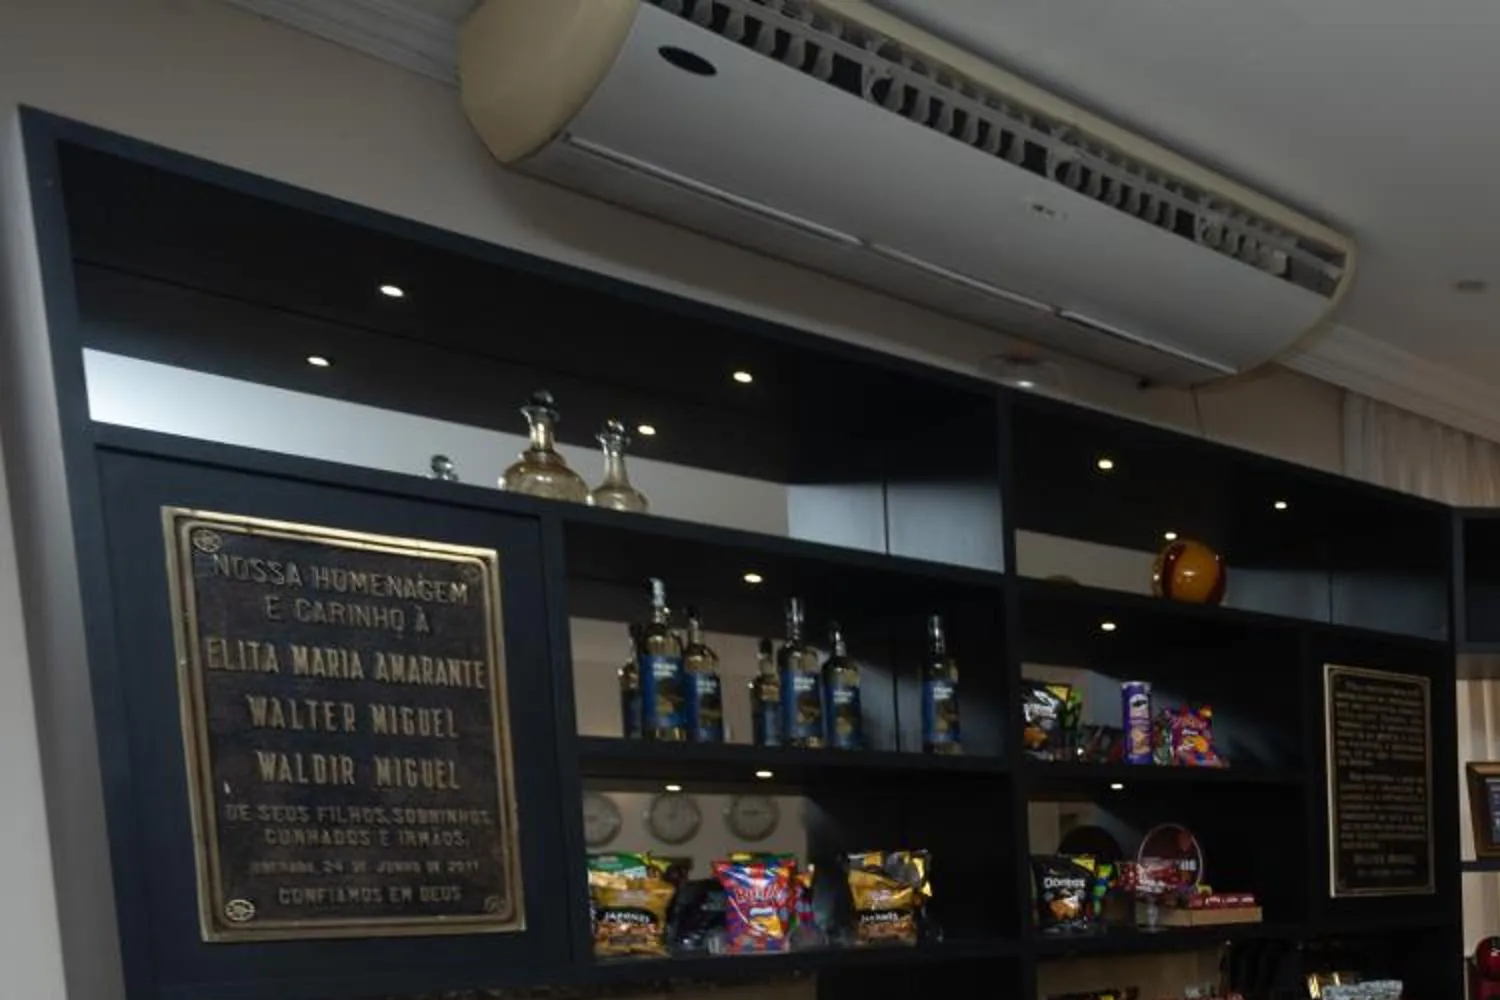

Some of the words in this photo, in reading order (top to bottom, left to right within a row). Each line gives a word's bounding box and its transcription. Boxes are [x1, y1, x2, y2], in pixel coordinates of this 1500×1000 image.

[212, 552, 303, 587] NOSSA
[312, 566, 468, 605] HOMENAGEM
[264, 594, 281, 621] E
[296, 597, 406, 630] CARINHO
[205, 637, 280, 674] ELITA
[290, 644, 365, 680] MARIA
[375, 651, 486, 689] AMARANTE
[245, 693, 356, 732] WALTER
[368, 703, 460, 738] MIGUEL
[255, 750, 356, 785] WALDIR
[373, 755, 461, 790] MIGUEL
[225, 804, 251, 821] DE
[256, 804, 310, 823] SEUS
[264, 828, 371, 846] CUNHADOS
[378, 829, 391, 847] E
[278, 886, 383, 904] CONFIAMOS
